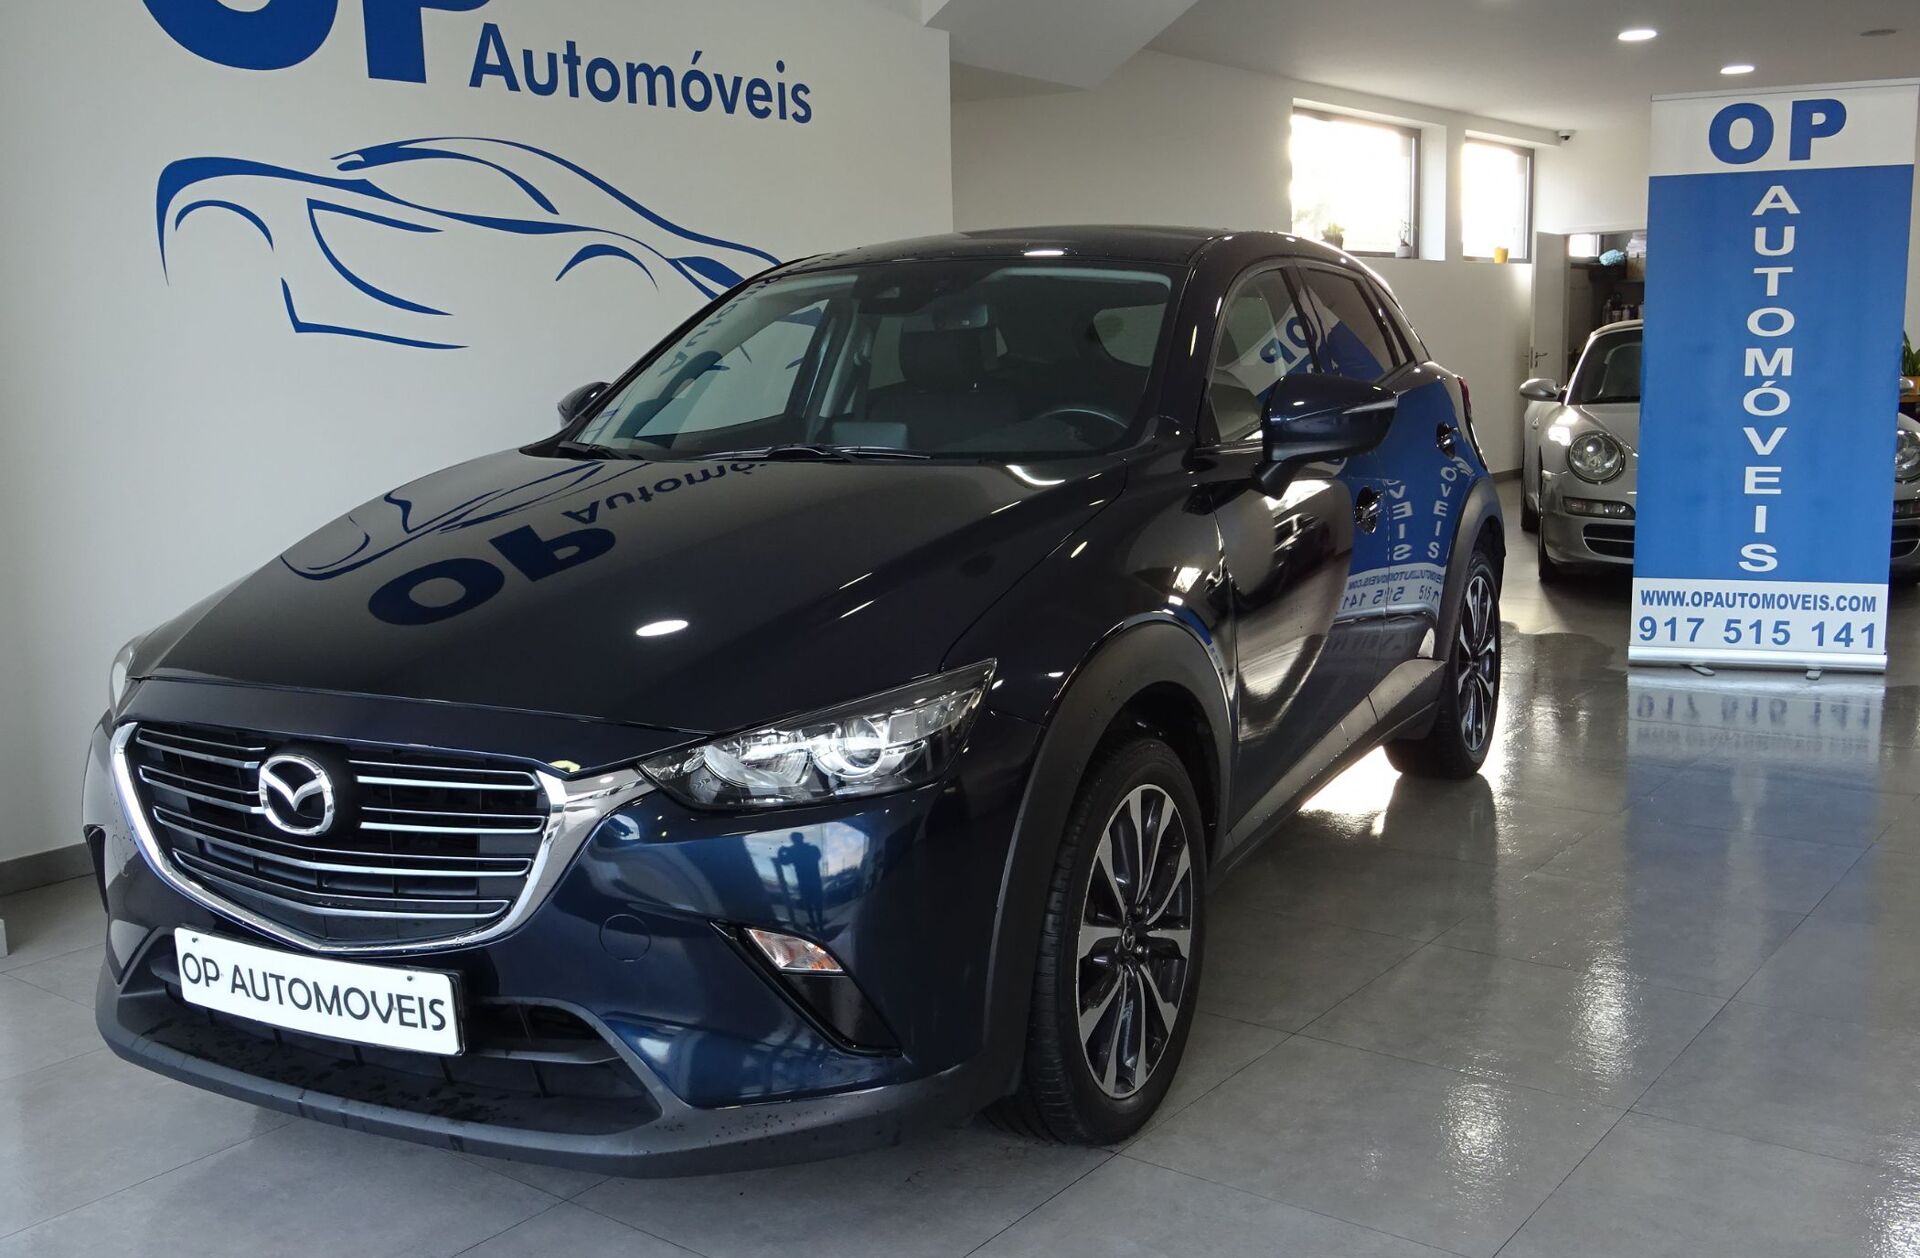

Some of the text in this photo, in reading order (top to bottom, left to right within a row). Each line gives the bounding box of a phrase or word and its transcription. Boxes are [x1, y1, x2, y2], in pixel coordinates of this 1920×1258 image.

[468, 22, 813, 124] Automóveis
[1708, 98, 1848, 165] OP
[1738, 185, 1801, 573] AUTOMÓVEIS
[1638, 615, 1876, 649] 917 515 141
[1640, 590, 1877, 613] WWW.OPAUTOMOVEIS.COM
[182, 951, 447, 1032] OP AUTOMOVEIS
